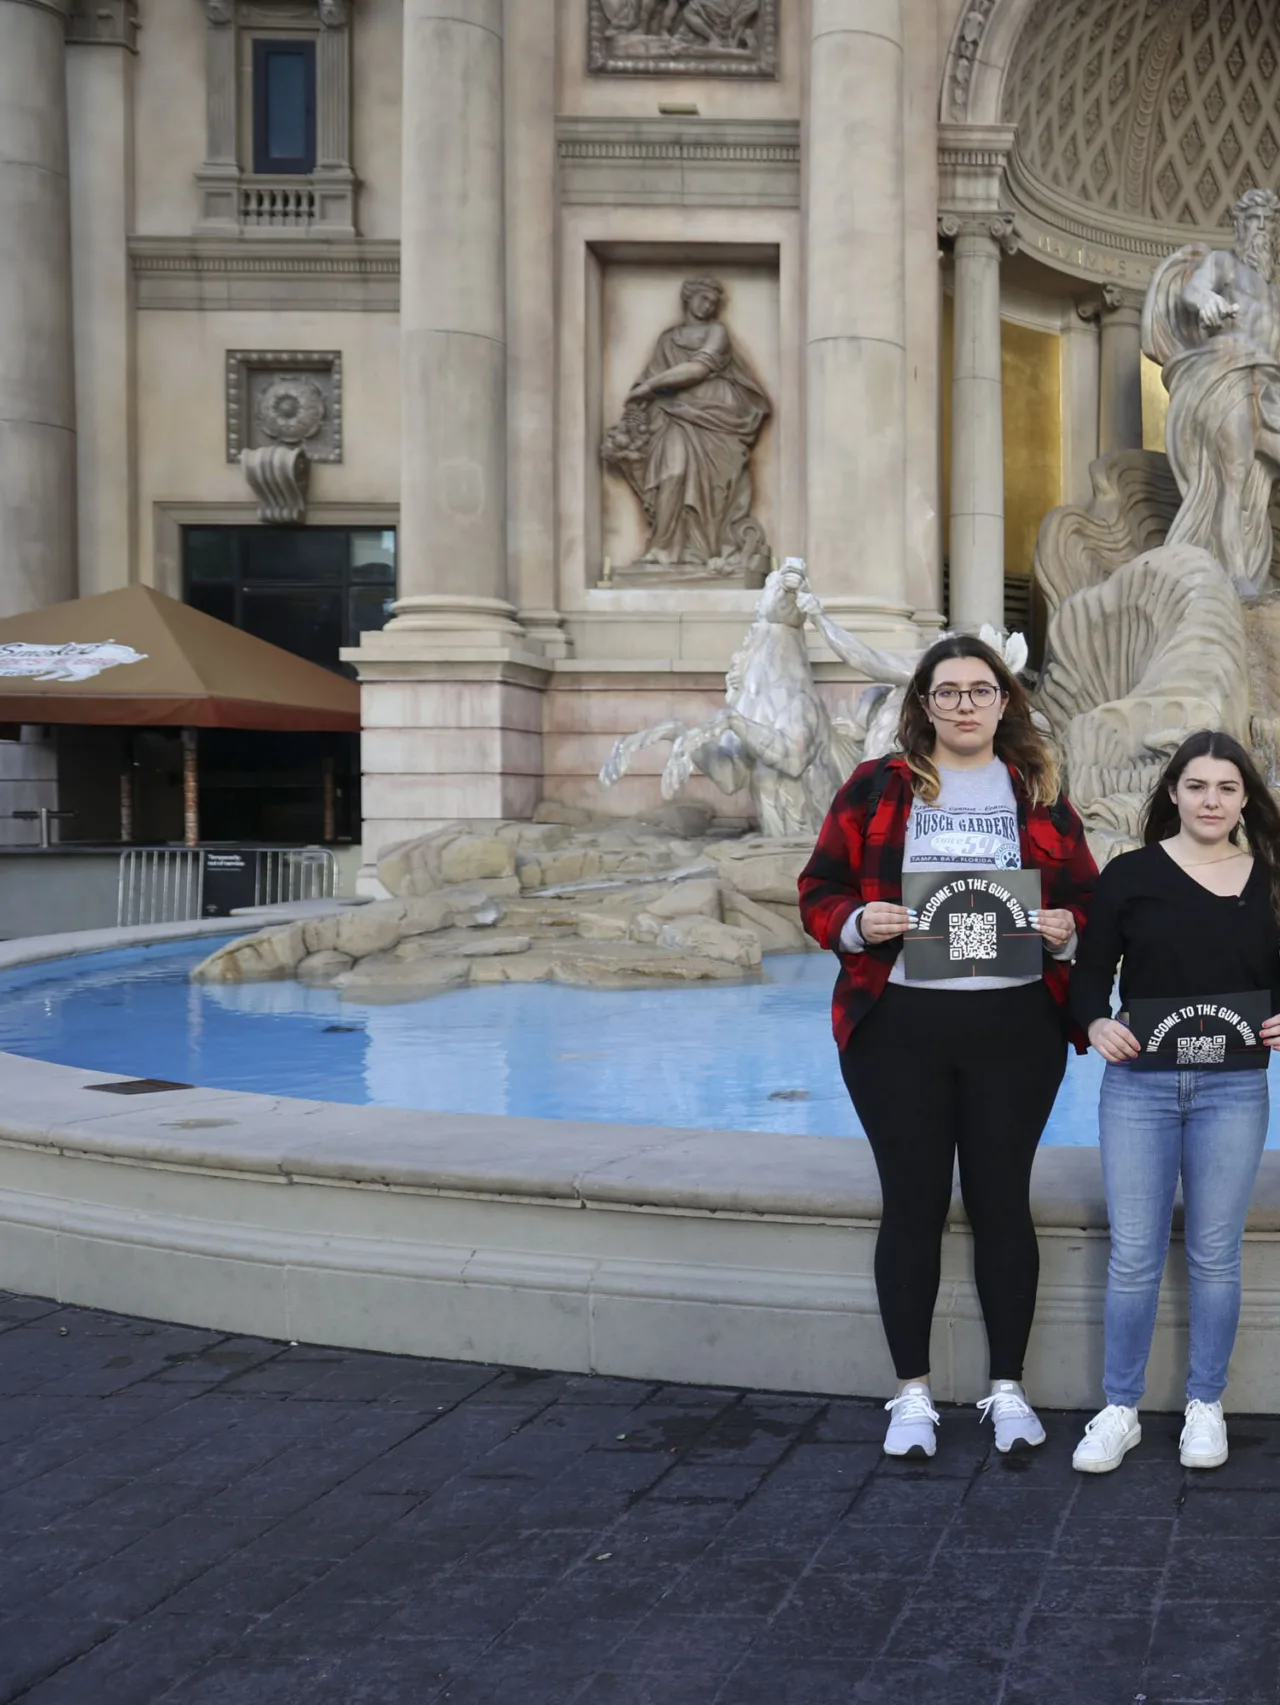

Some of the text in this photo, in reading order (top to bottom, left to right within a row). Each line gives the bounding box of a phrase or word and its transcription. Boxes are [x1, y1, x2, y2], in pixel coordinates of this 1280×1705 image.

[914, 812, 1016, 843] BUSCH GARDENS
[918, 878, 1027, 932] WELCOME TO THE GUN SHOW
[1146, 1004, 1257, 1053] WELCOME TO THE GUN SHOW
